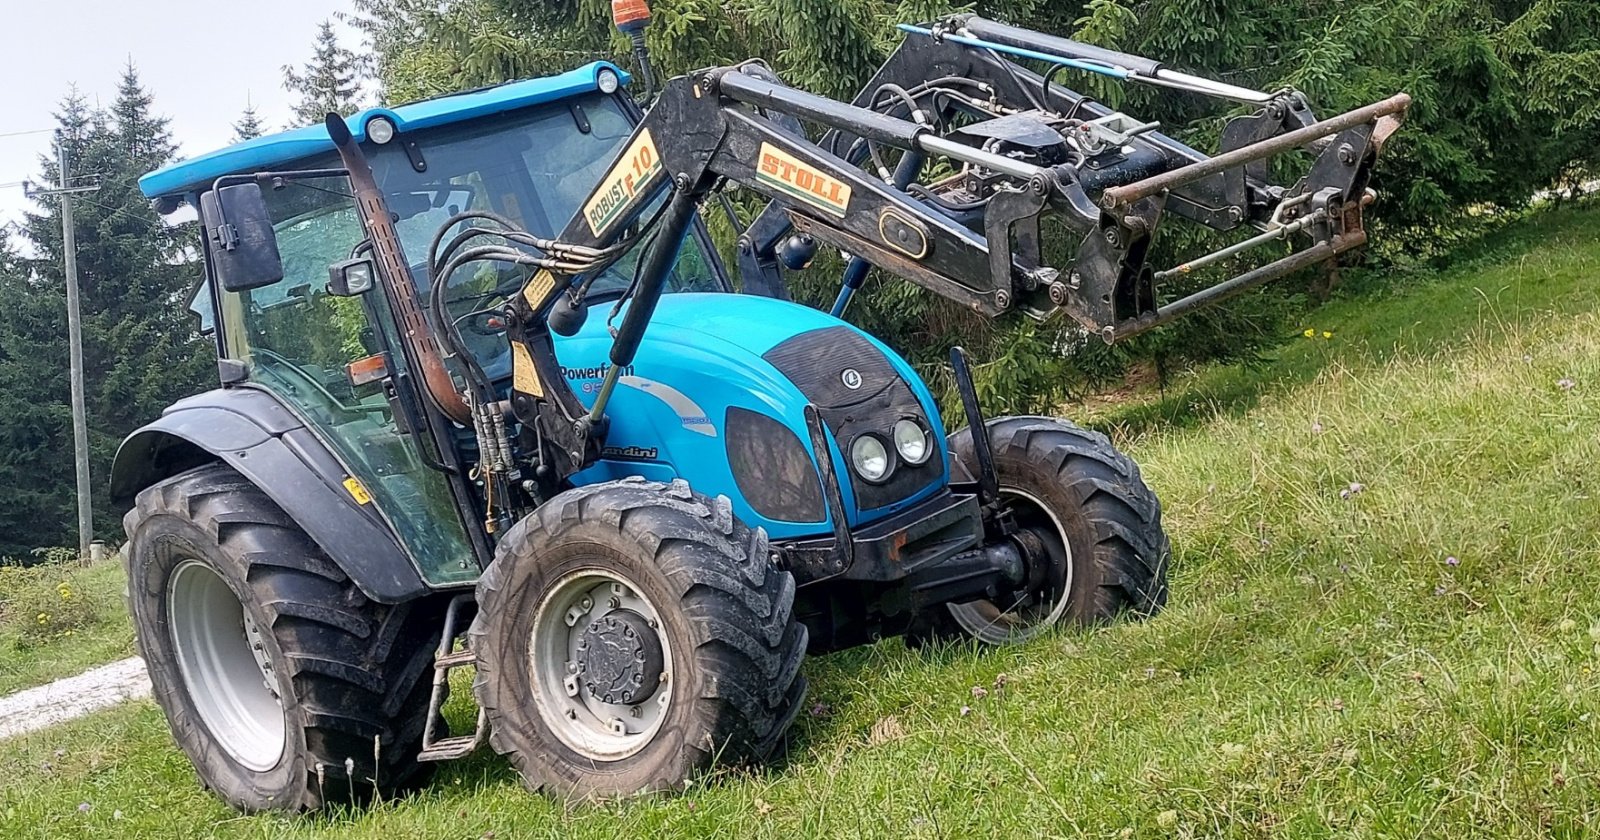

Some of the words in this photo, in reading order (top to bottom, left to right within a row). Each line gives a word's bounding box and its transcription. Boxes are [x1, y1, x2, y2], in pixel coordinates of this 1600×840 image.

[762, 153, 844, 206] STOLL
[589, 178, 625, 227] ROBUST
[560, 363, 634, 380] Powerfm
[600, 447, 656, 458] andini
